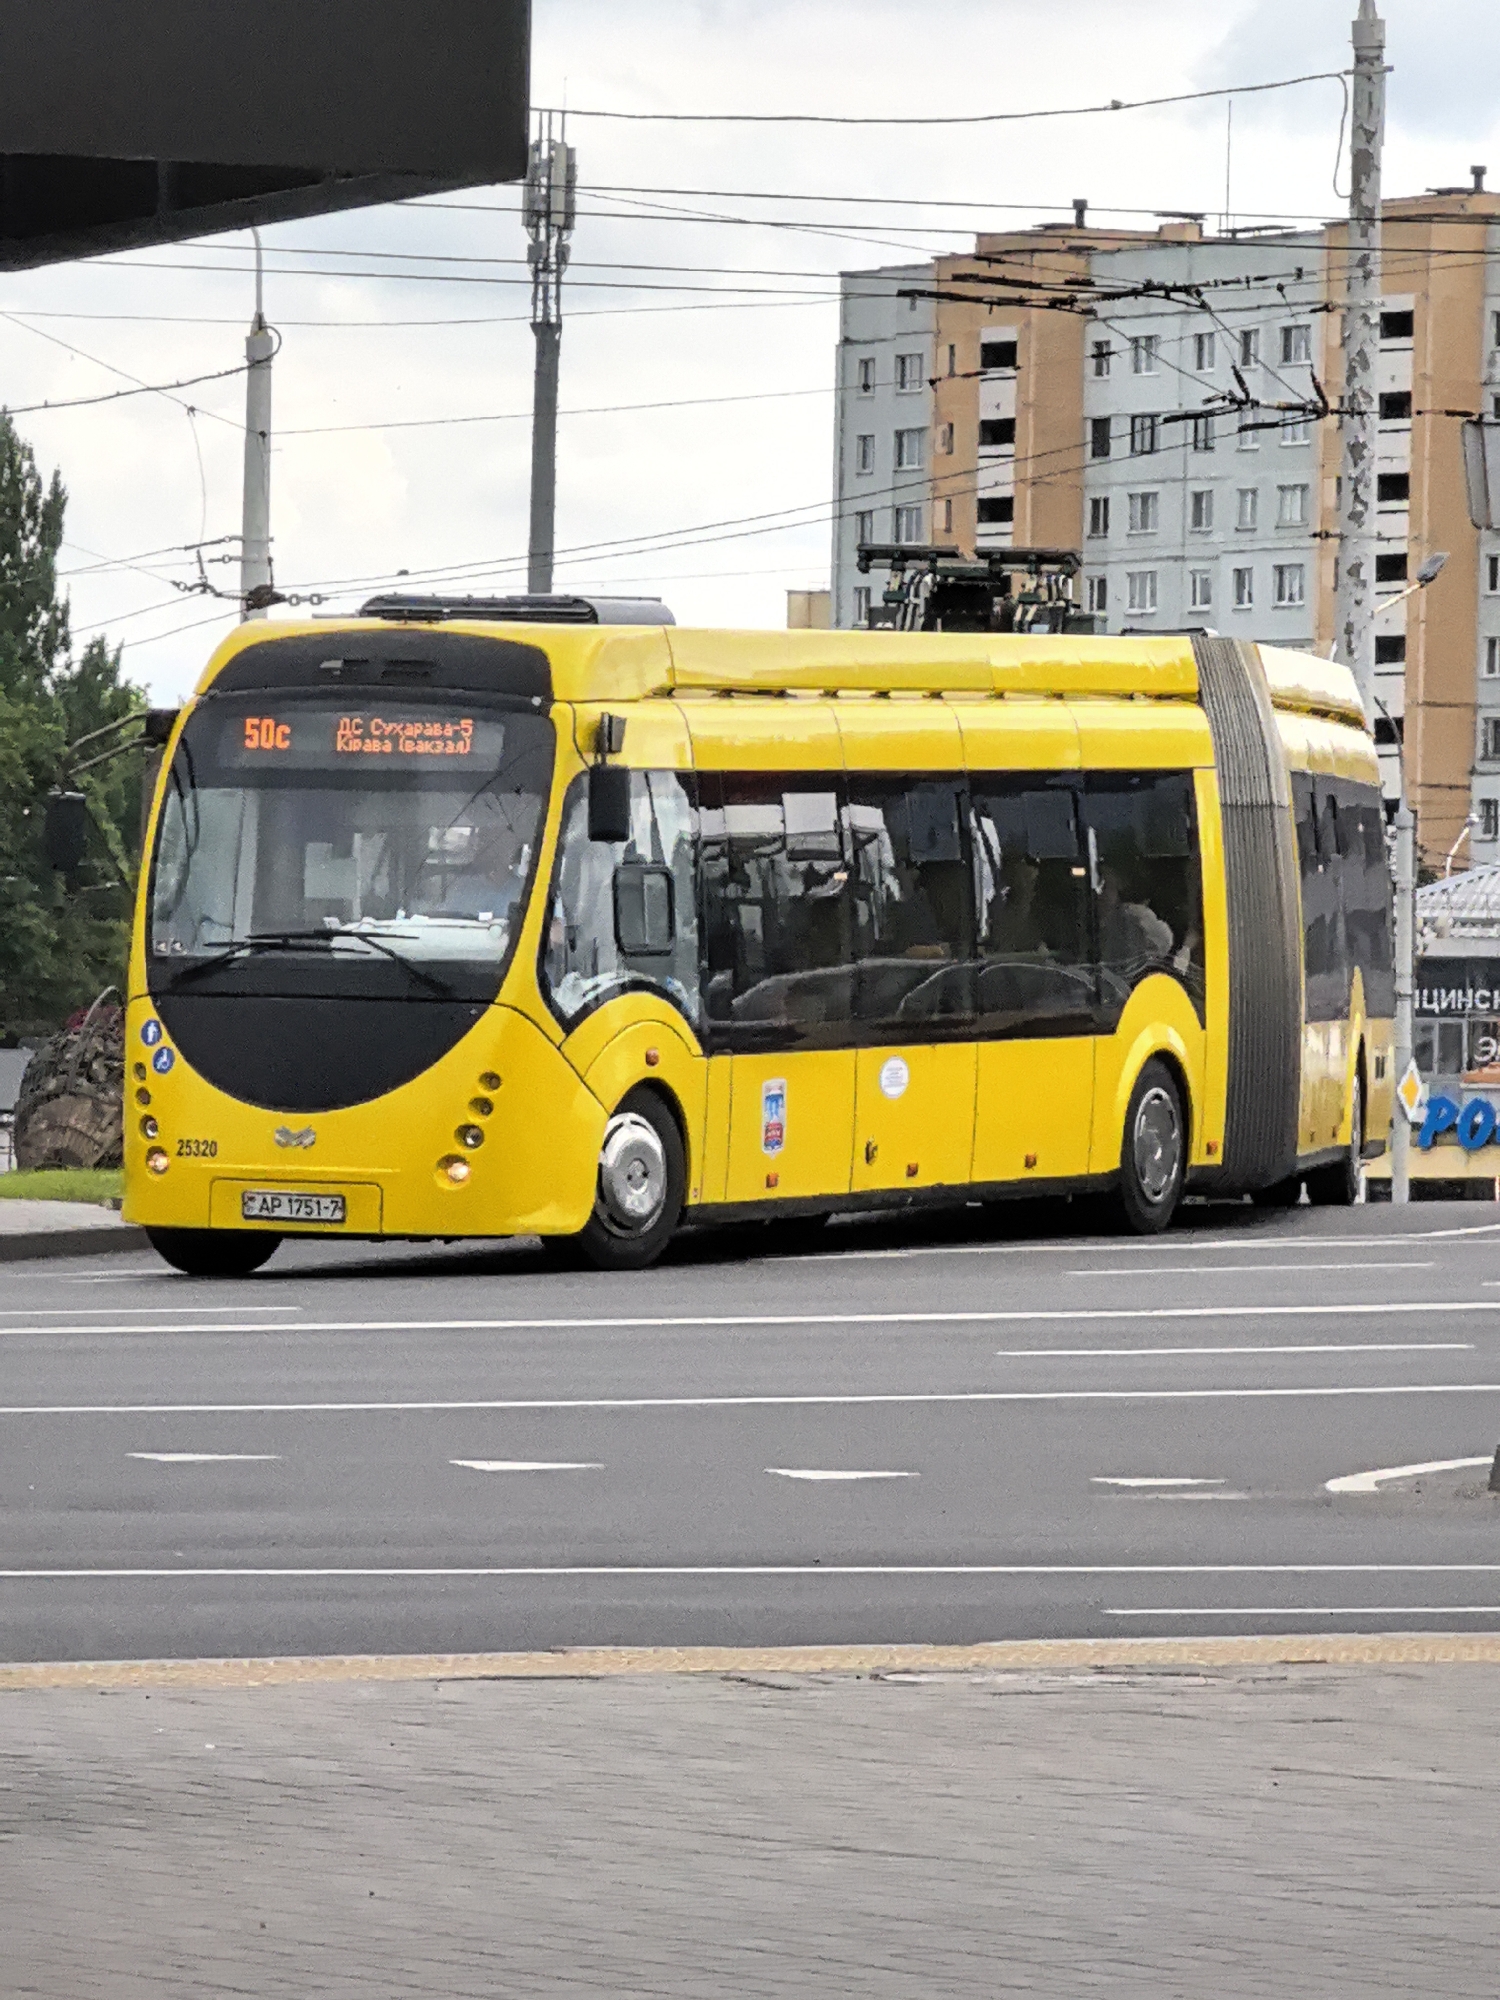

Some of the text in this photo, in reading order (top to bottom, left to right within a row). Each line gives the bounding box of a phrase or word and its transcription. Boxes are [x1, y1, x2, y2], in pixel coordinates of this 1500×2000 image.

[338, 717, 474, 738] ДС Сухарава-5
[336, 731, 471, 754] Кірава (вакзал)
[1474, 1036, 1500, 1062] Э
[1418, 1096, 1500, 1150] РО
[176, 1139, 218, 1158] 25320
[259, 1196, 340, 1217] AP 1751-7
